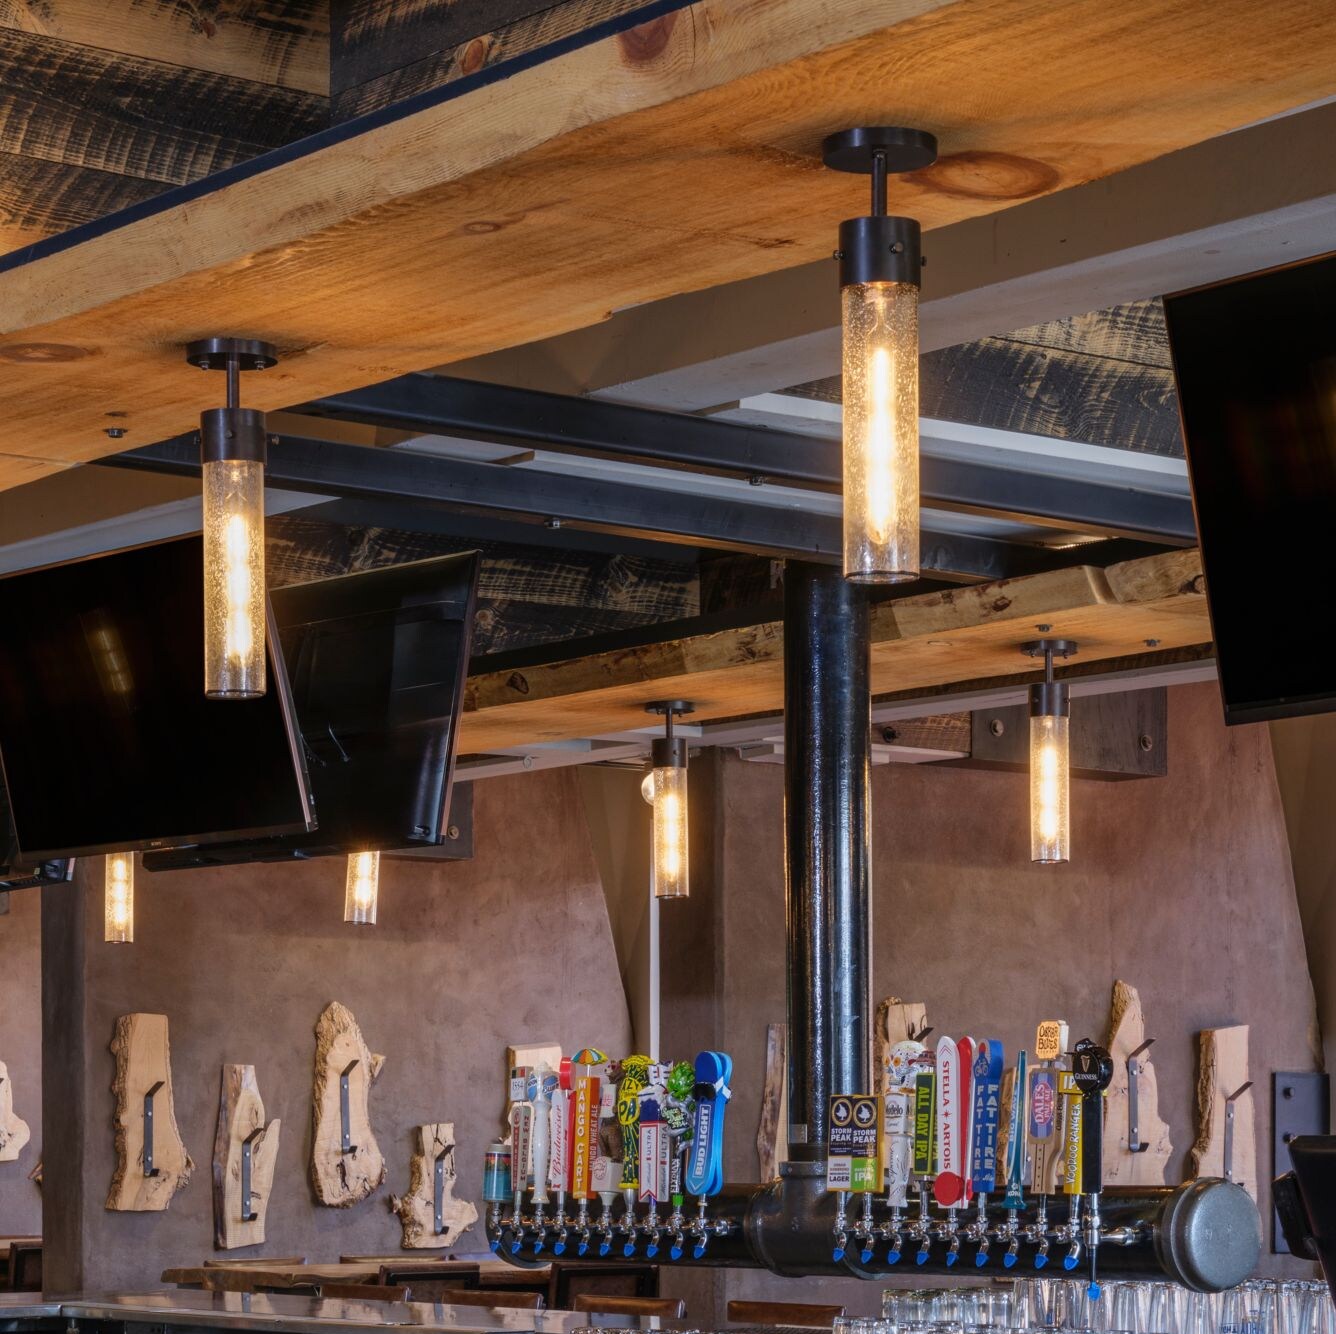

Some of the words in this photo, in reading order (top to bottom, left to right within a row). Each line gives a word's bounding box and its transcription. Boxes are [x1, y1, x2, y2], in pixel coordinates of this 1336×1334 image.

[942, 1060, 950, 1107] STELLA
[1063, 1075, 1080, 1090] IP
[1074, 1072, 1097, 1080] GUINNESS
[577, 1079, 587, 1137] MANGO
[918, 1086, 930, 1109] ALL
[976, 1085, 984, 1119] FAT
[986, 1084, 999, 1119] FAT
[590, 1119, 598, 1144] WHEAT
[699, 1107, 709, 1146] LIGHT
[830, 1134, 851, 1142] PEAK
[917, 1113, 929, 1136] DAY
[1070, 1103, 1081, 1143] RANGER
[551, 1104, 562, 1178] Budweiser
[916, 1140, 928, 1160] IPA
[943, 1123, 951, 1169] ARTOIS
[974, 1124, 983, 1170] TIRE
[984, 1123, 997, 1169] TIRE
[576, 1143, 585, 1188] CART
[695, 1147, 706, 1176] BUD
[854, 1172, 871, 1182] IPA
[1066, 1144, 1079, 1184] VOODOO
